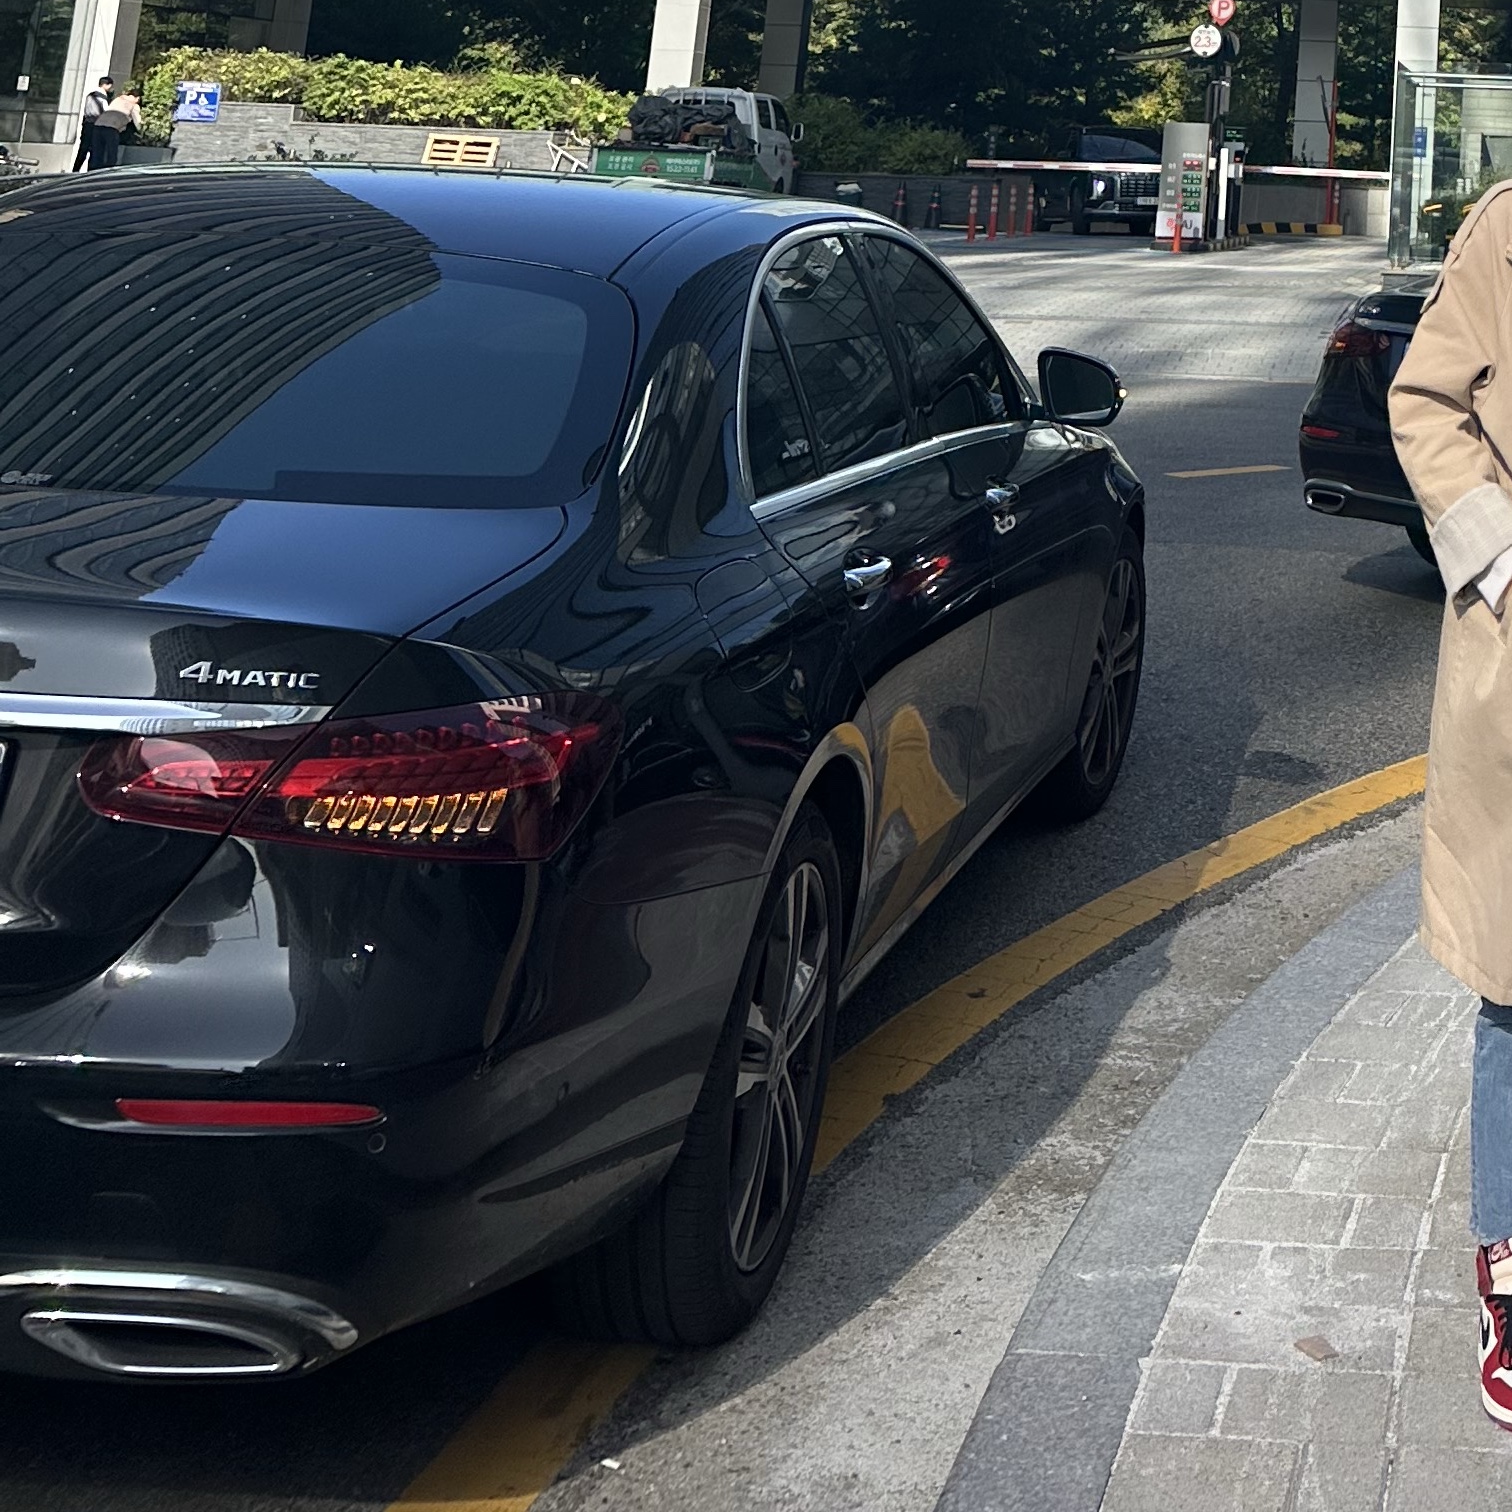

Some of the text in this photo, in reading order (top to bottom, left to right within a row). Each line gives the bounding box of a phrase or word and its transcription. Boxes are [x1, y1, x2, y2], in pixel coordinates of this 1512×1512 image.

[1217, 0, 1230, 17] P
[185, 90, 198, 105] P
[179, 660, 321, 689] 4MATIC
